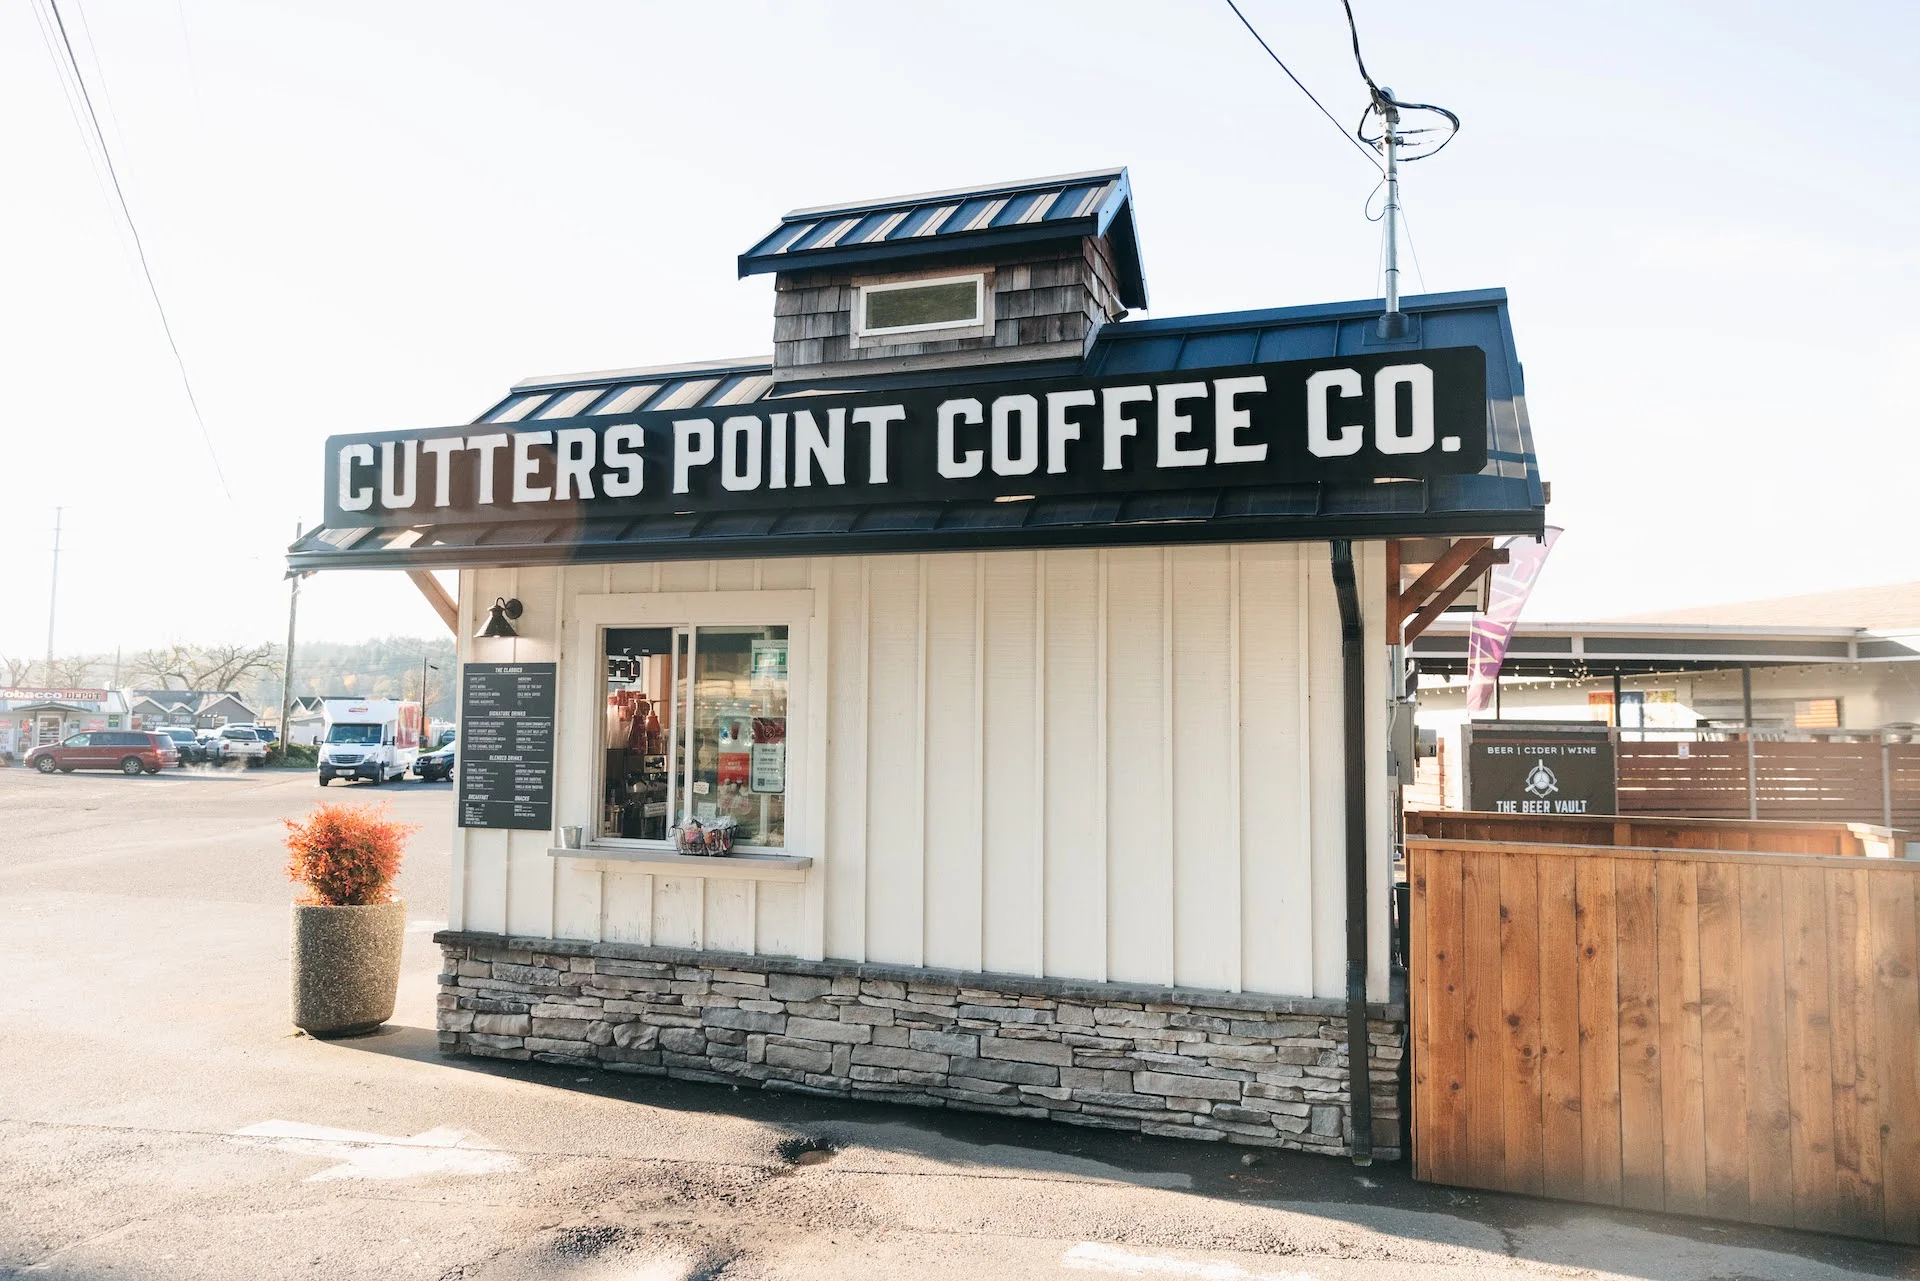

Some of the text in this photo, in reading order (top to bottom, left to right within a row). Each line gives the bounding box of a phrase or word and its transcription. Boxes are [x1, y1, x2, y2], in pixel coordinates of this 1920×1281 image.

[337, 363, 1462, 512] CUTTERS POINT COFFEE CO.
[66, 692, 101, 700] DEPOT
[1496, 800, 1587, 813] THE BEER VAULT
